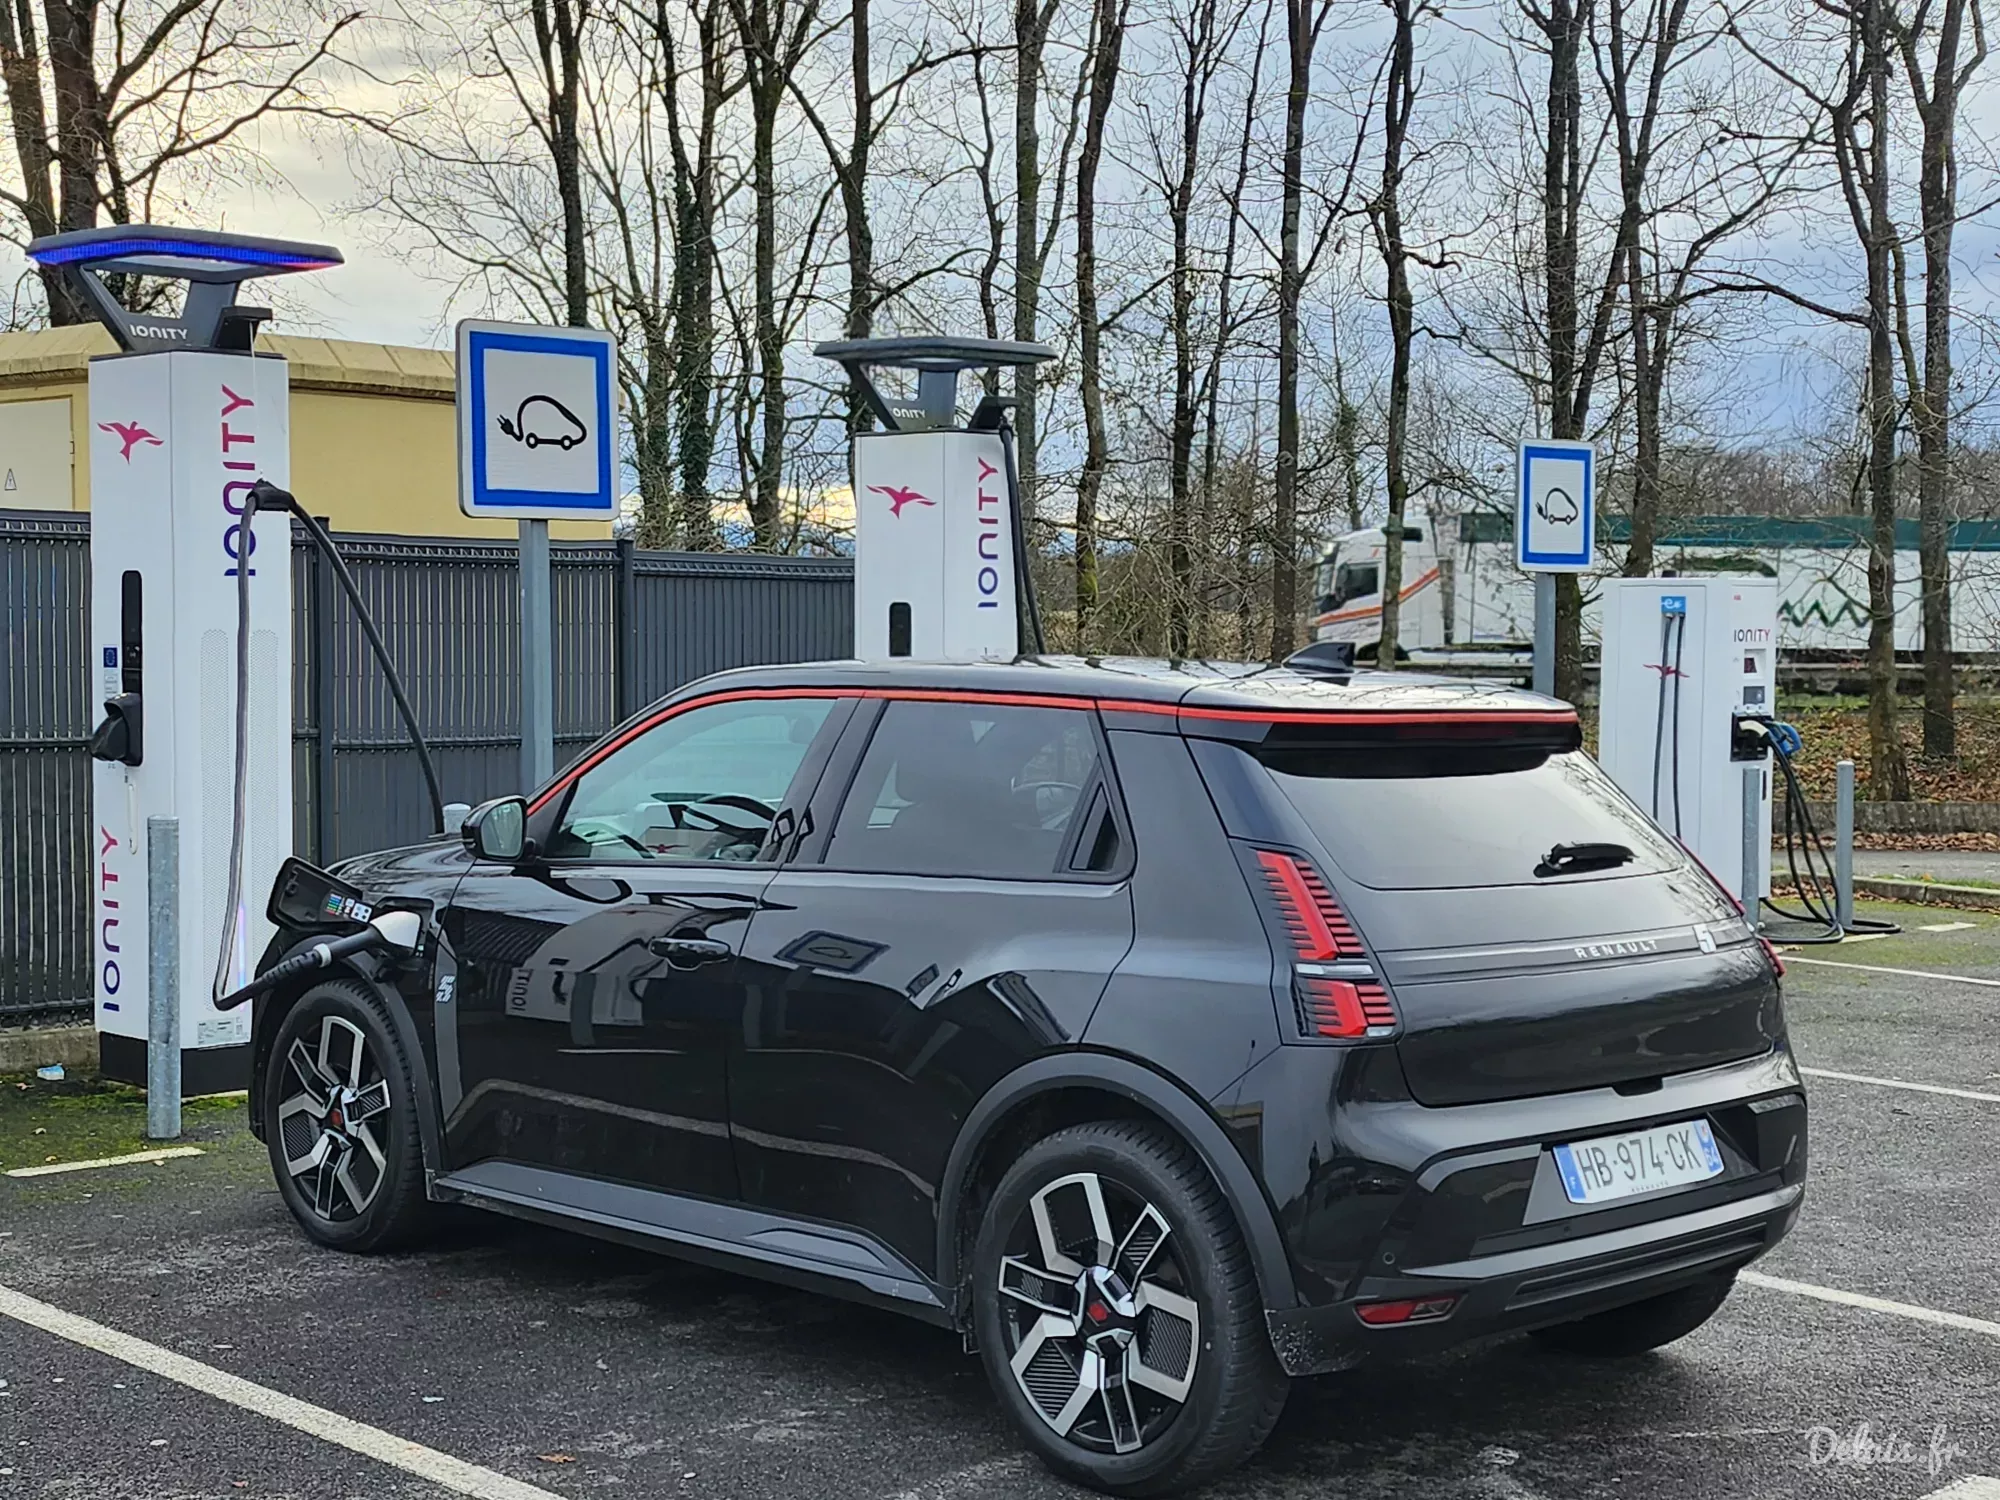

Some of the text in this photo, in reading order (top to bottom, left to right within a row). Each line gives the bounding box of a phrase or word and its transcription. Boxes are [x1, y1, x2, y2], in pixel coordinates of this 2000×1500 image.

[130, 324, 188, 340] IONITY
[891, 407, 926, 419] ONITY
[977, 456, 999, 608] IONITY
[1733, 628, 1771, 643] IONITY
[100, 825, 121, 1012] IONITY
[1574, 940, 1658, 959] RENAULT
